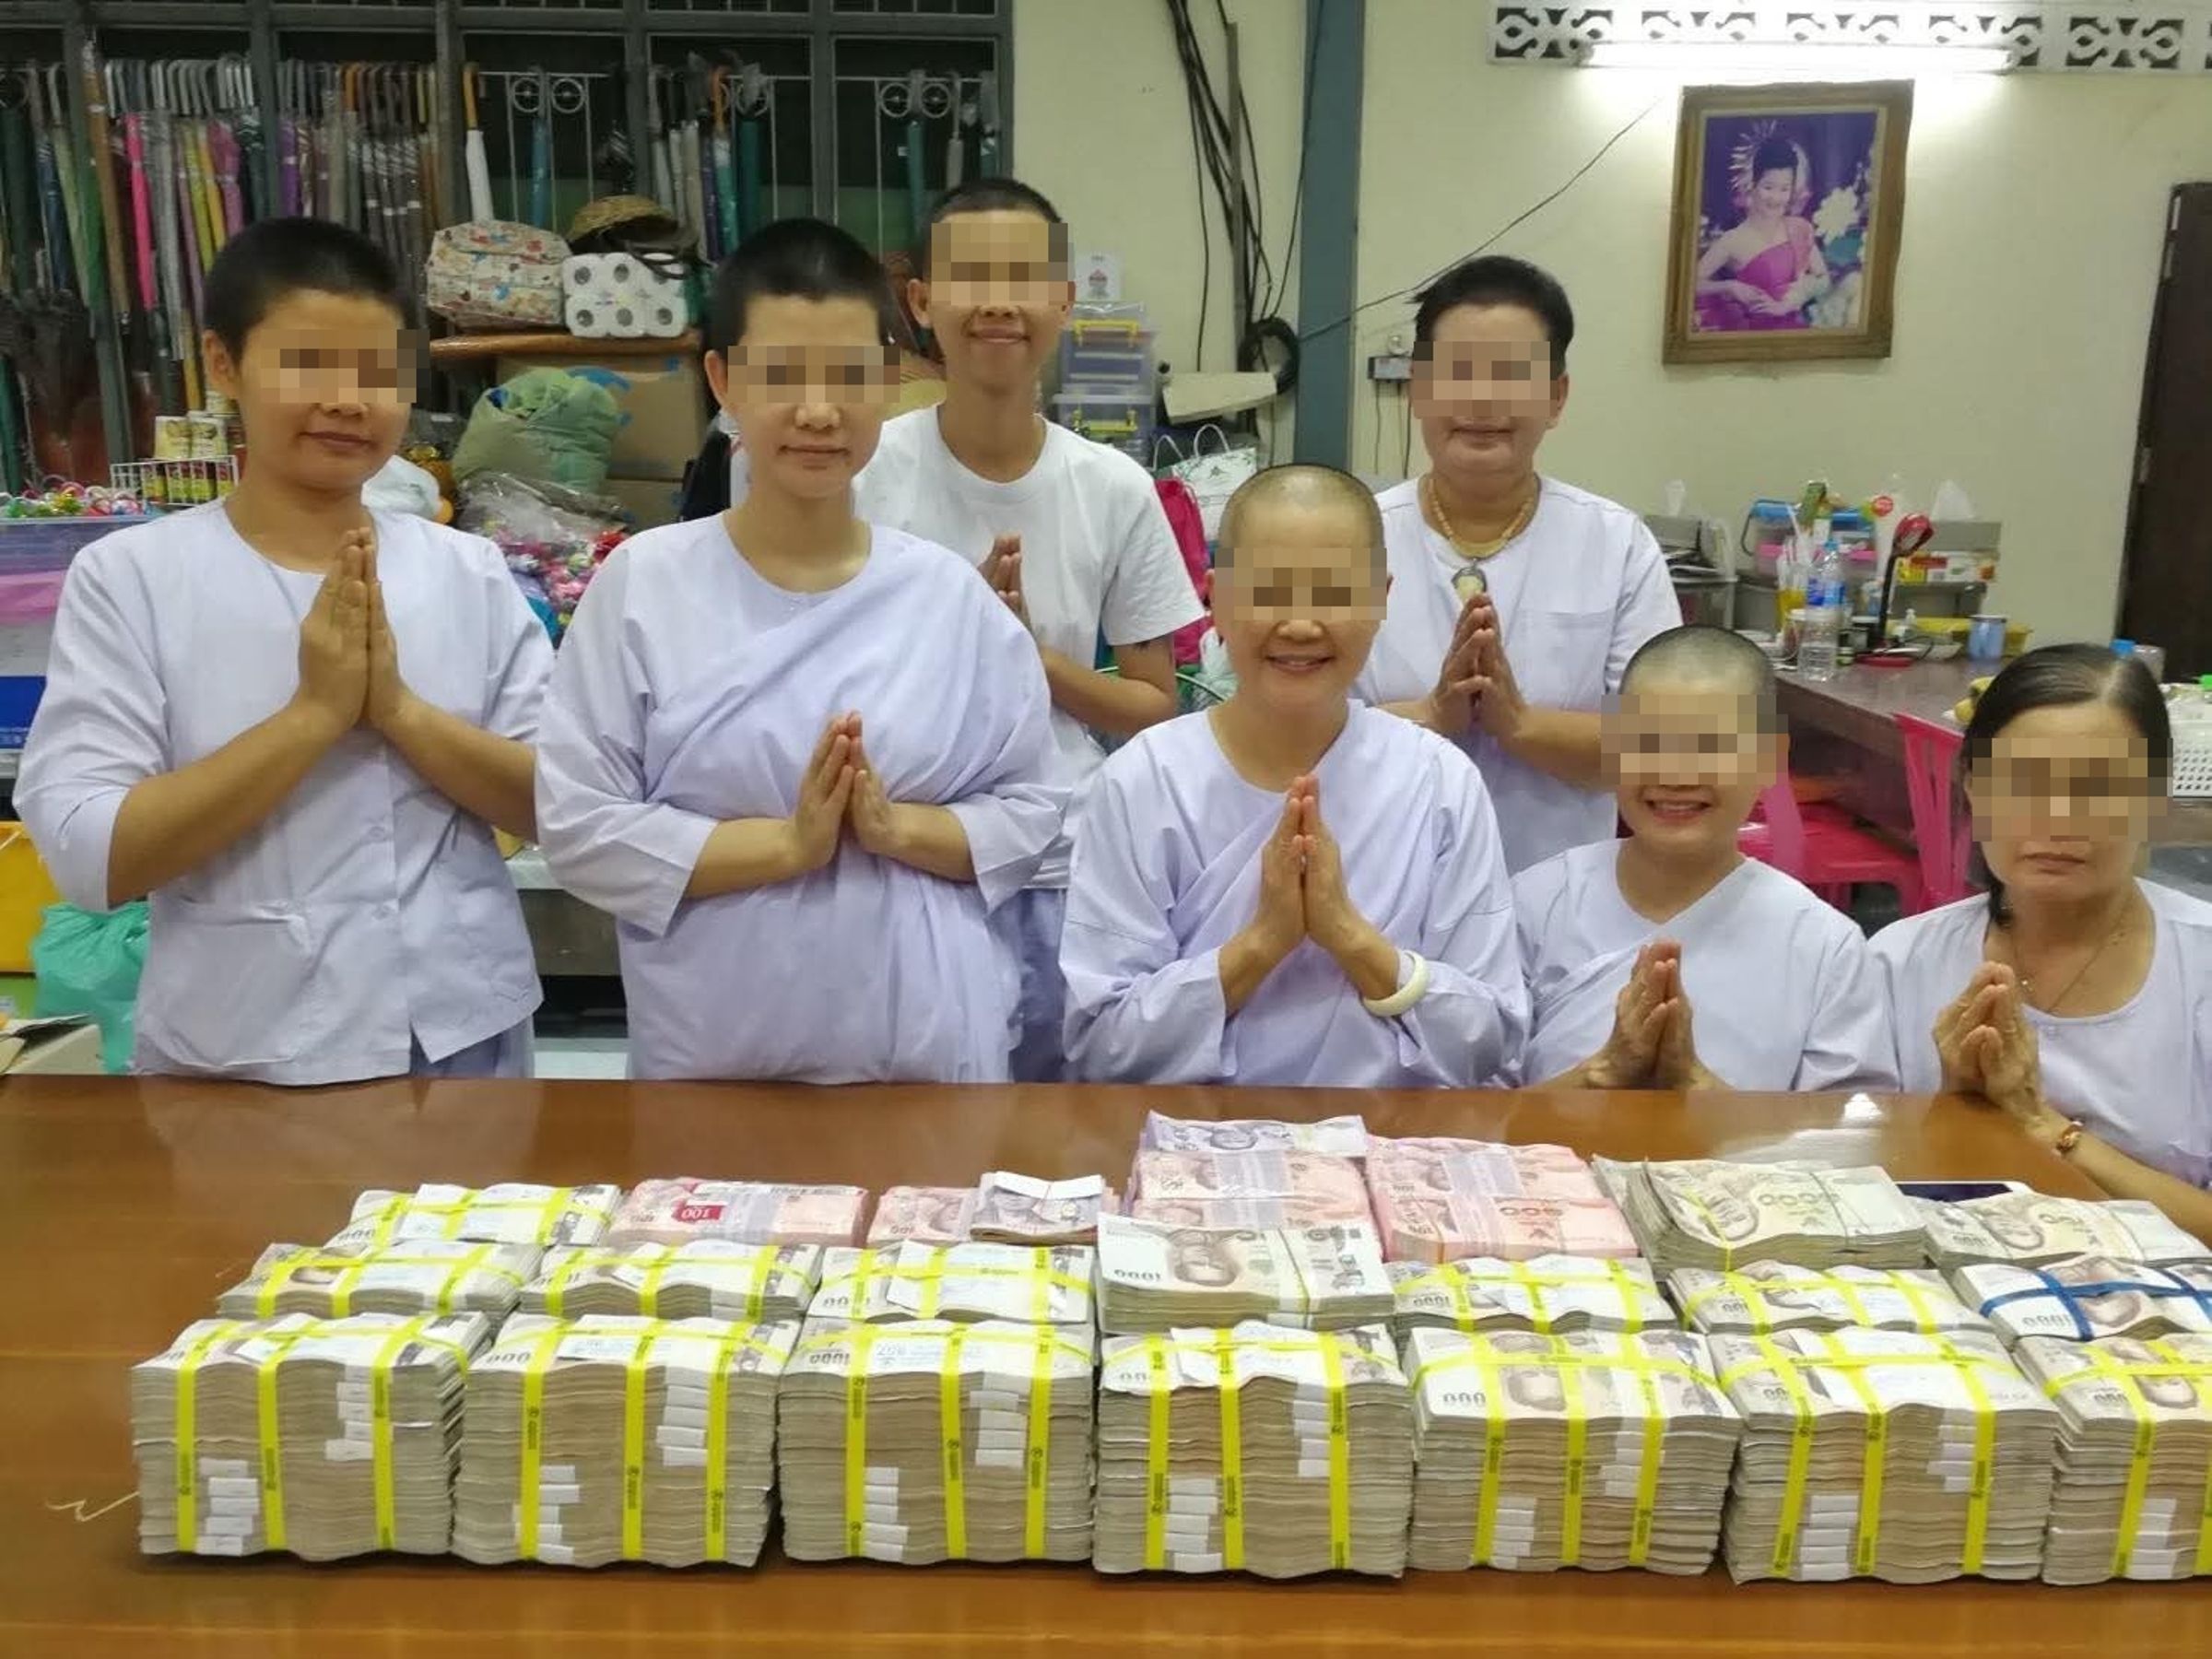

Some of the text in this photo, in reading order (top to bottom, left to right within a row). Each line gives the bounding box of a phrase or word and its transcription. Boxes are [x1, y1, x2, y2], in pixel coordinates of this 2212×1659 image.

[681, 1206, 712, 1219] 100
[338, 1228, 376, 1241] 000
[1114, 1268, 1162, 1281] 1000
[823, 1296, 871, 1308] 100
[1413, 1296, 1451, 1307] 1000
[2022, 1313, 2071, 1328] 1000
[486, 1351, 531, 1365] 000
[809, 1352, 851, 1366] 1000
[1442, 1392, 1487, 1405] 000
[2092, 1392, 2128, 1404] 000
